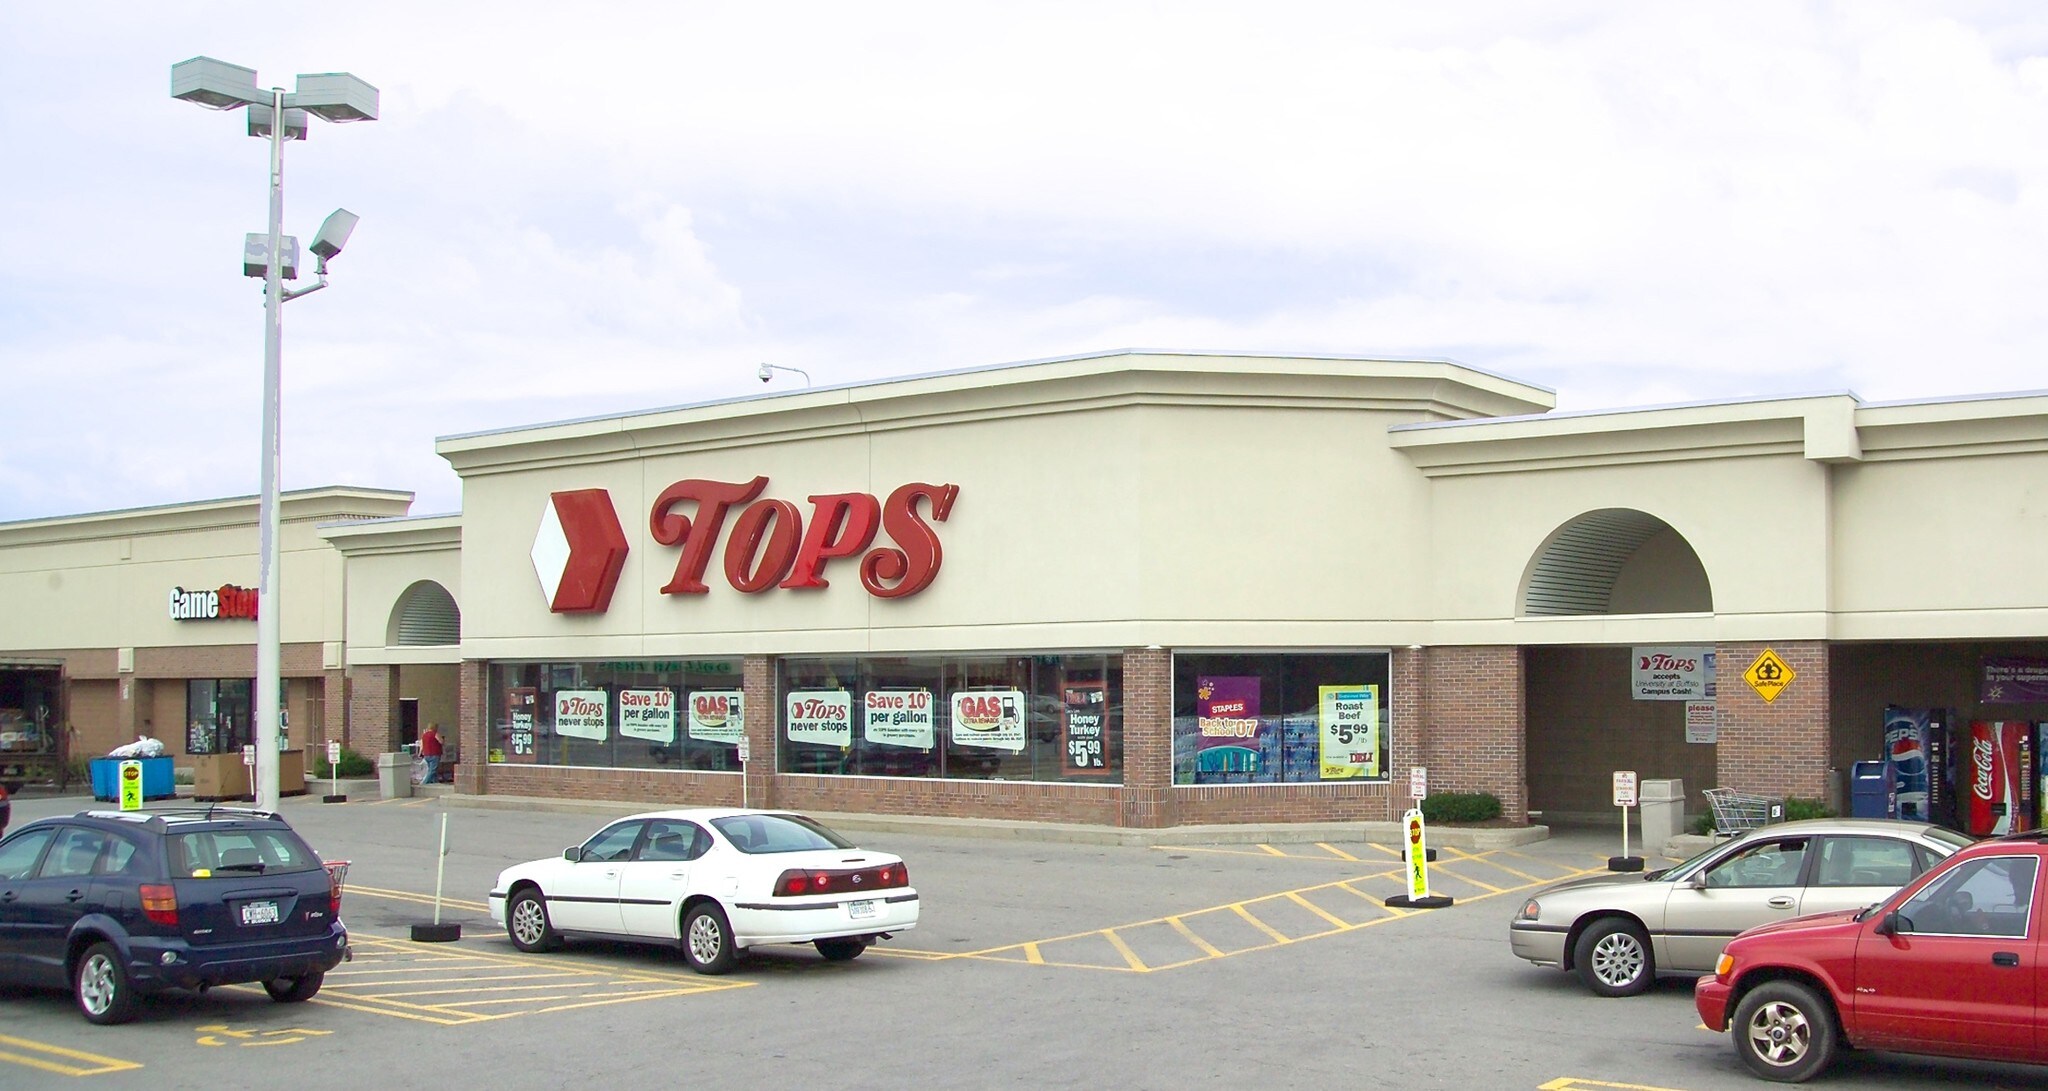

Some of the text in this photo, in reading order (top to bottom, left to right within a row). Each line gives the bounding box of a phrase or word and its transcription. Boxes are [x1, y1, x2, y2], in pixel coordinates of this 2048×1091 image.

[649, 475, 959, 598] TOPS
[1651, 654, 1697, 672] TOPS
[621, 692, 651, 706] Save
[696, 695, 728, 715] GAS
[867, 692, 903, 709] Save
[570, 697, 604, 717] TOPS
[804, 699, 847, 720] TOPS
[961, 696, 1002, 718] GAS
[1212, 703, 1243, 714] STAPLES
[1336, 702, 1363, 711] Roast
[624, 707, 670, 721] per gallon
[870, 710, 927, 725] per gallon
[1070, 714, 1099, 726] Honey
[1339, 711, 1361, 720] Beef
[558, 717, 604, 728] never stops
[790, 720, 848, 733] never stops
[1200, 718, 1222, 727] Back
[1069, 725, 1100, 736] Turkey
[1203, 727, 1235, 736] School
[1093, 758, 1103, 767] lb.
[1349, 752, 1373, 763] DELI
